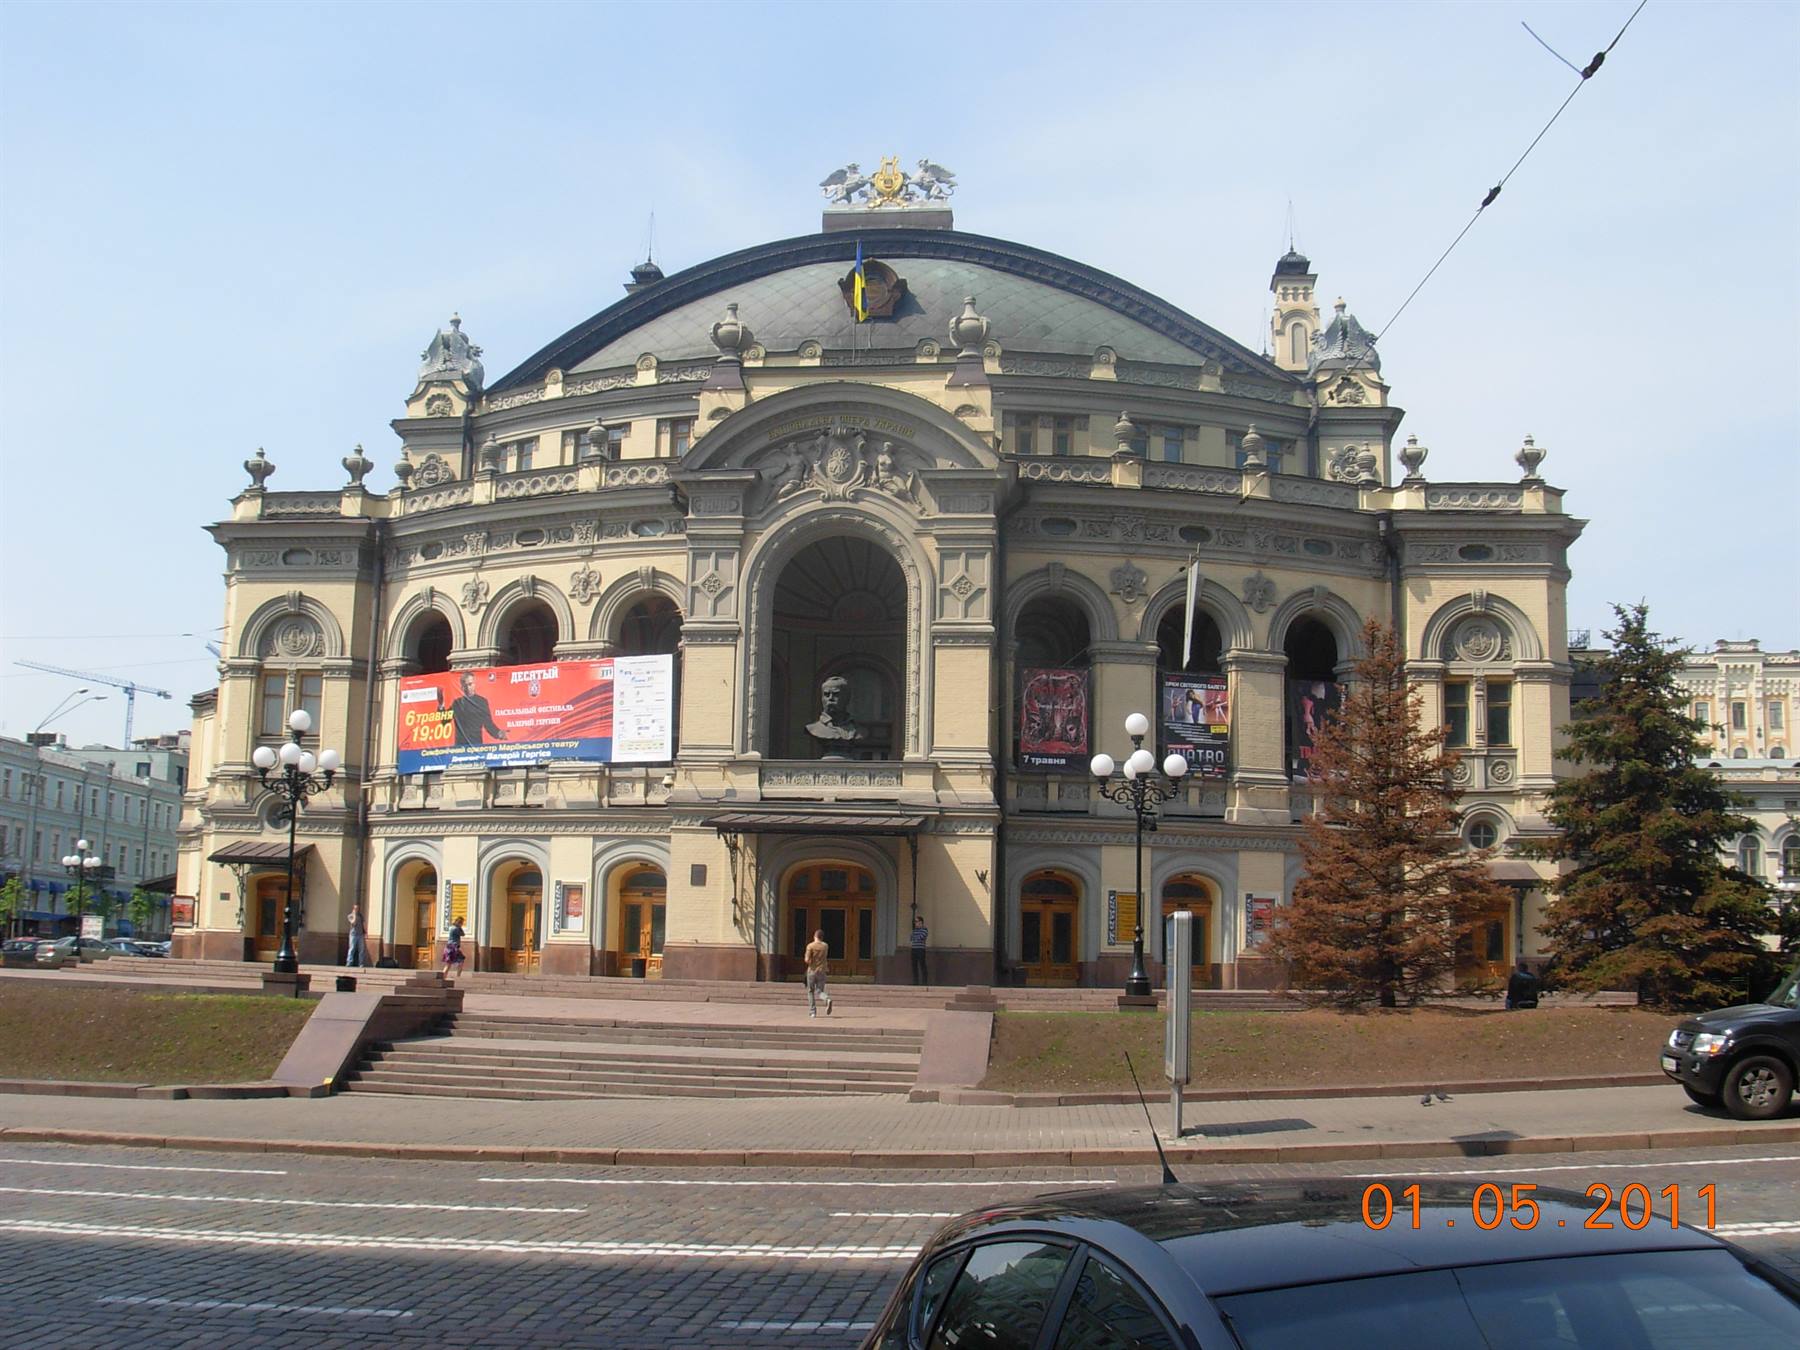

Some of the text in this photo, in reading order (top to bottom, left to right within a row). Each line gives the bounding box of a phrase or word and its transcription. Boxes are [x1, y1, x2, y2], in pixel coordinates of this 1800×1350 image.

[510, 666, 559, 684] ДЕСЯТЫЙ
[405, 710, 454, 726] 6 травня
[412, 722, 453, 742] 19:00
[551, 741, 579, 749] театру
[1023, 754, 1067, 766] 7 травня
